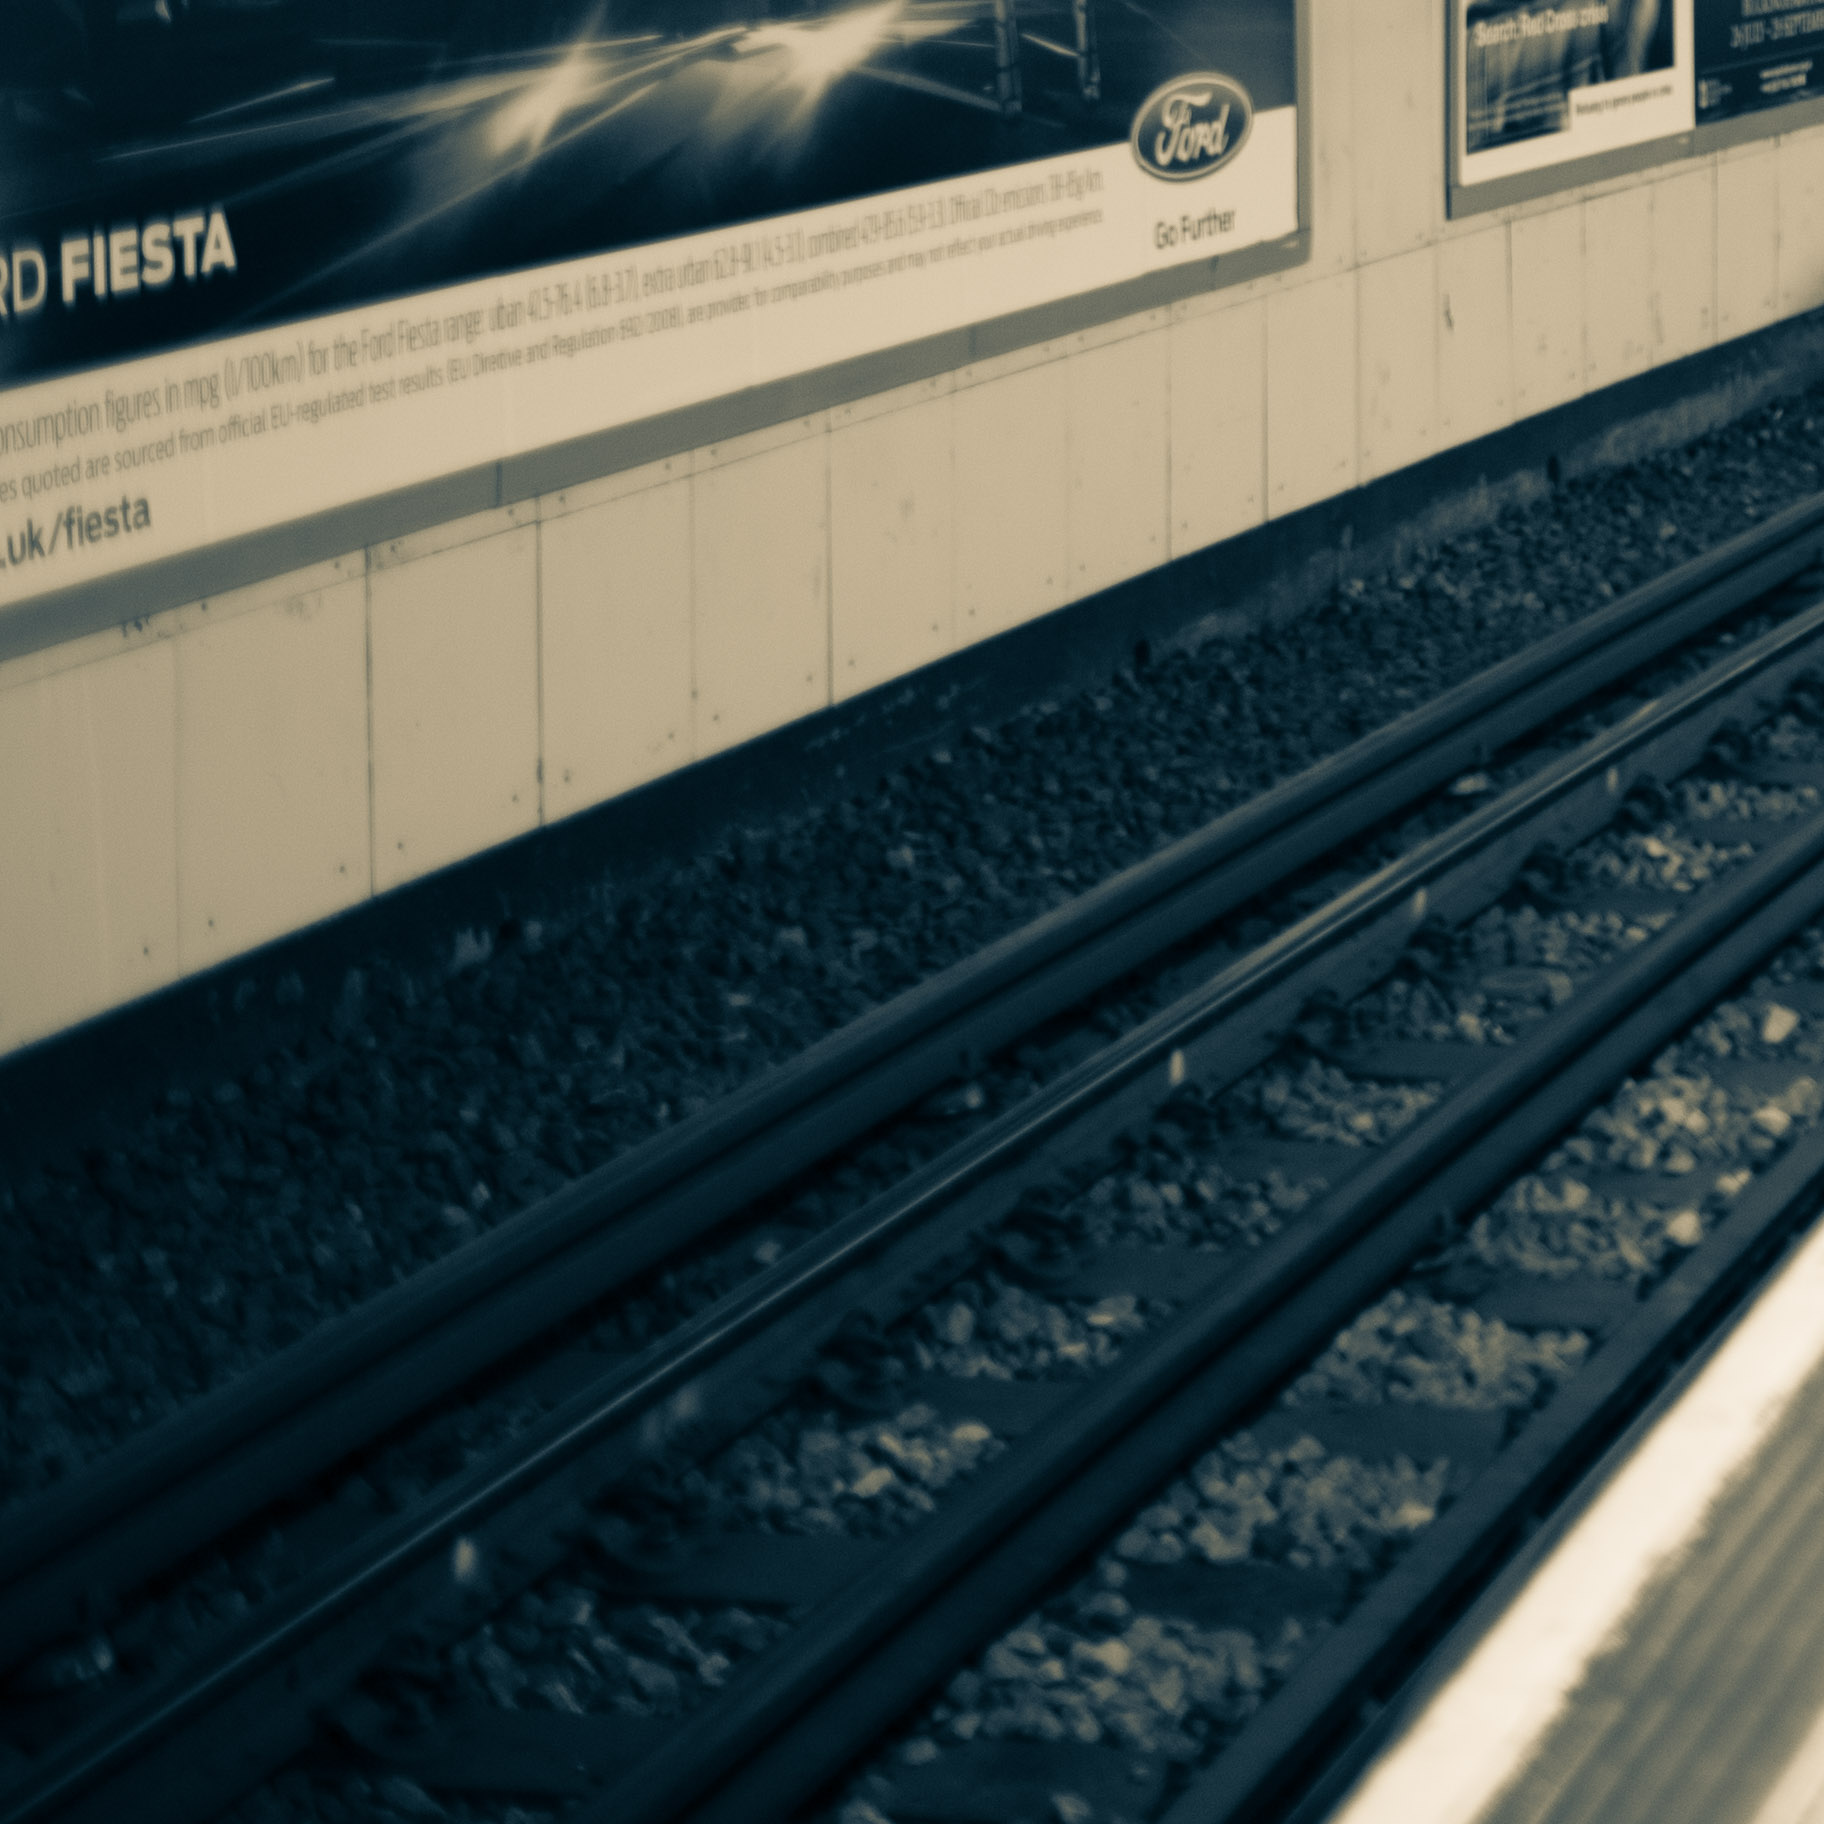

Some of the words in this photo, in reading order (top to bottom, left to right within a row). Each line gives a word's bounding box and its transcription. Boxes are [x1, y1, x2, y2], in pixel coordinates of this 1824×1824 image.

[1156, 91, 1230, 166] Ford
[62, 205, 237, 304] FIESTA
[1153, 221, 1178, 250] Go
[1182, 206, 1236, 242] Further
[105, 389, 160, 433] figures
[165, 379, 179, 412] in
[184, 374, 219, 410] mpg
[309, 340, 329, 376] for
[333, 333, 357, 368] the
[361, 329, 394, 363] Ford
[400, 318, 442, 354] Fiesta
[21, 456, 80, 500] quoted
[85, 453, 111, 480] are
[114, 431, 174, 472] sourced
[179, 423, 216, 454] from
[219, 410, 267, 445] official
